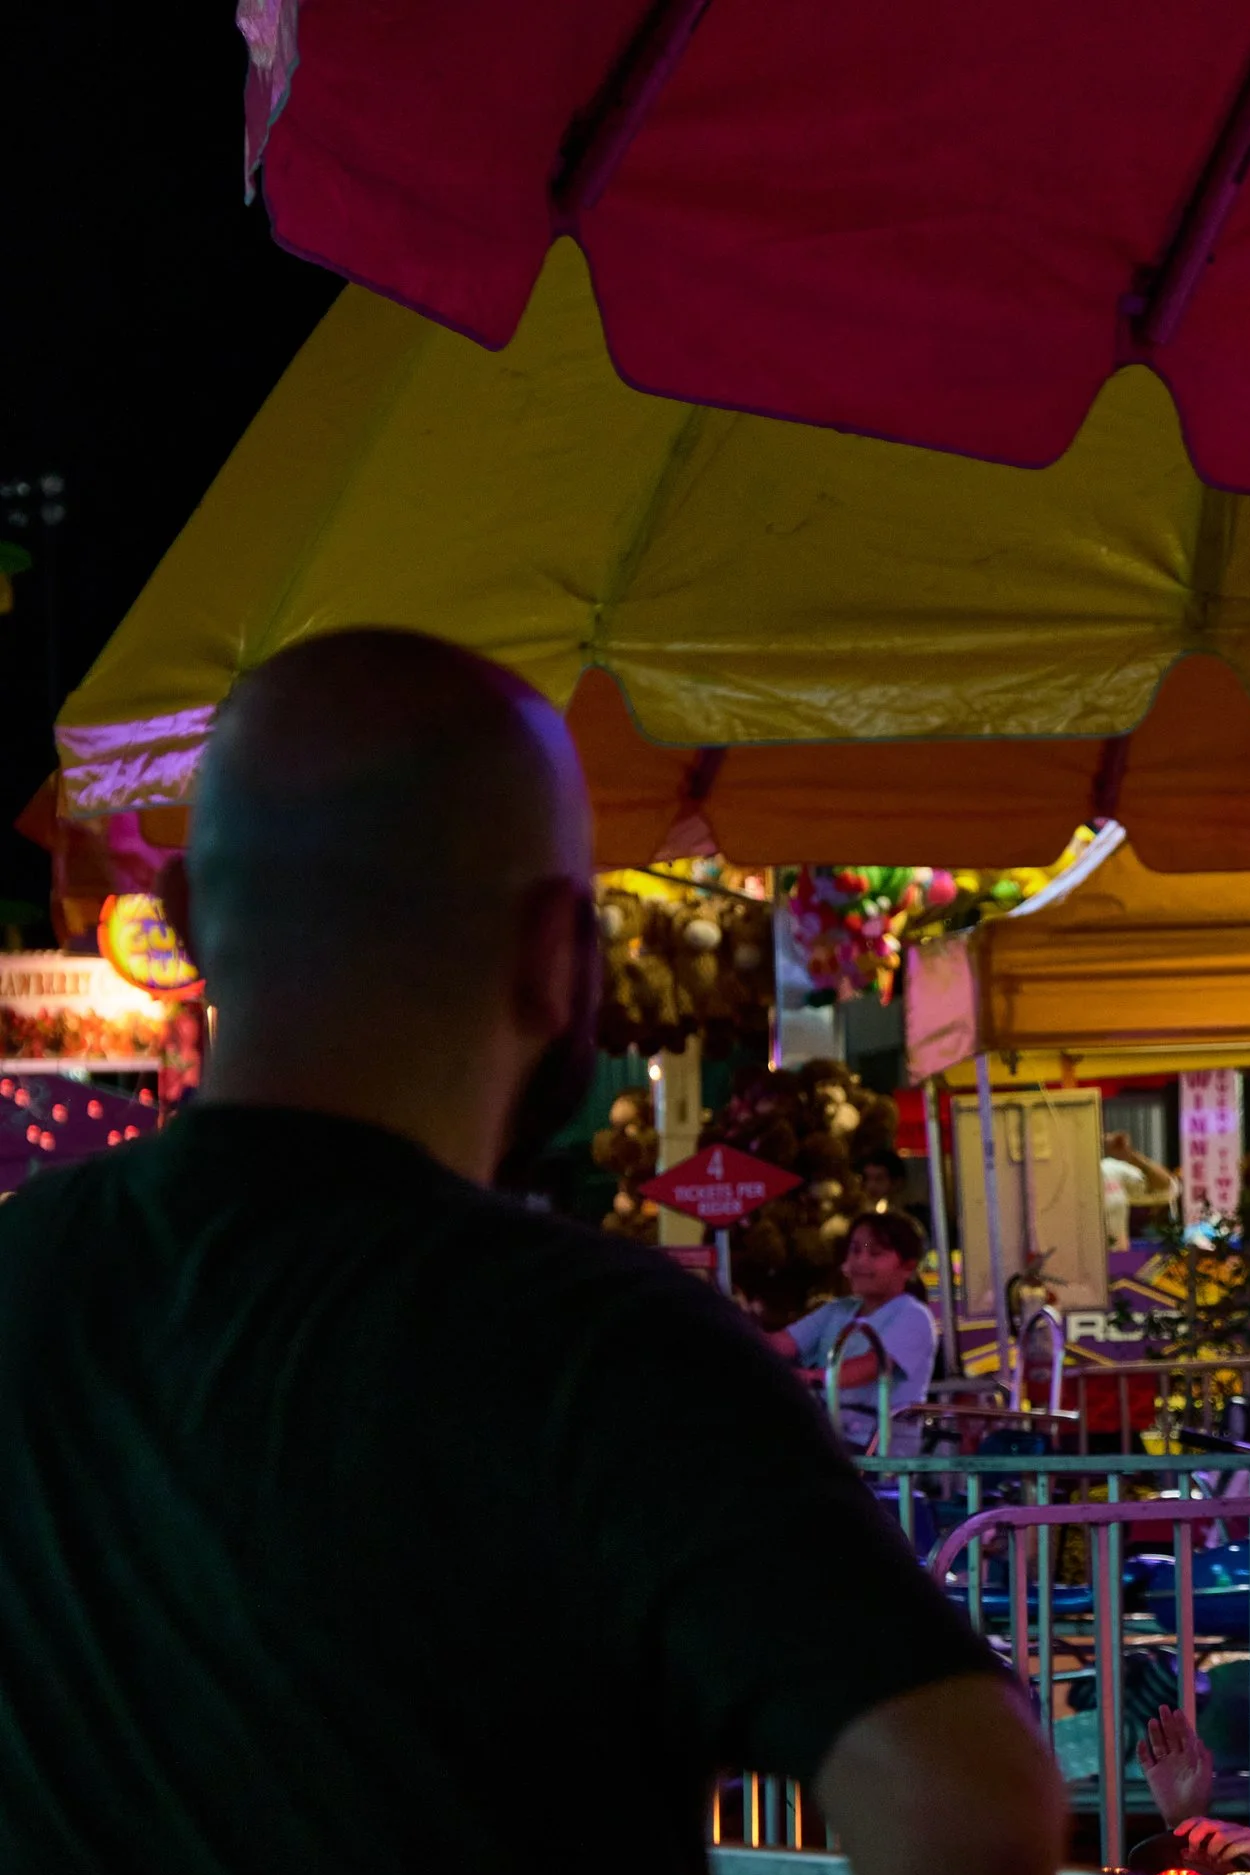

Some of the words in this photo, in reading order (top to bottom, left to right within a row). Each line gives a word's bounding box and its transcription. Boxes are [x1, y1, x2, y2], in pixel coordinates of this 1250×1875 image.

[706, 1149, 725, 1181] 4
[675, 1183, 733, 1202] TICKETS
[737, 1181, 765, 1199] PER
